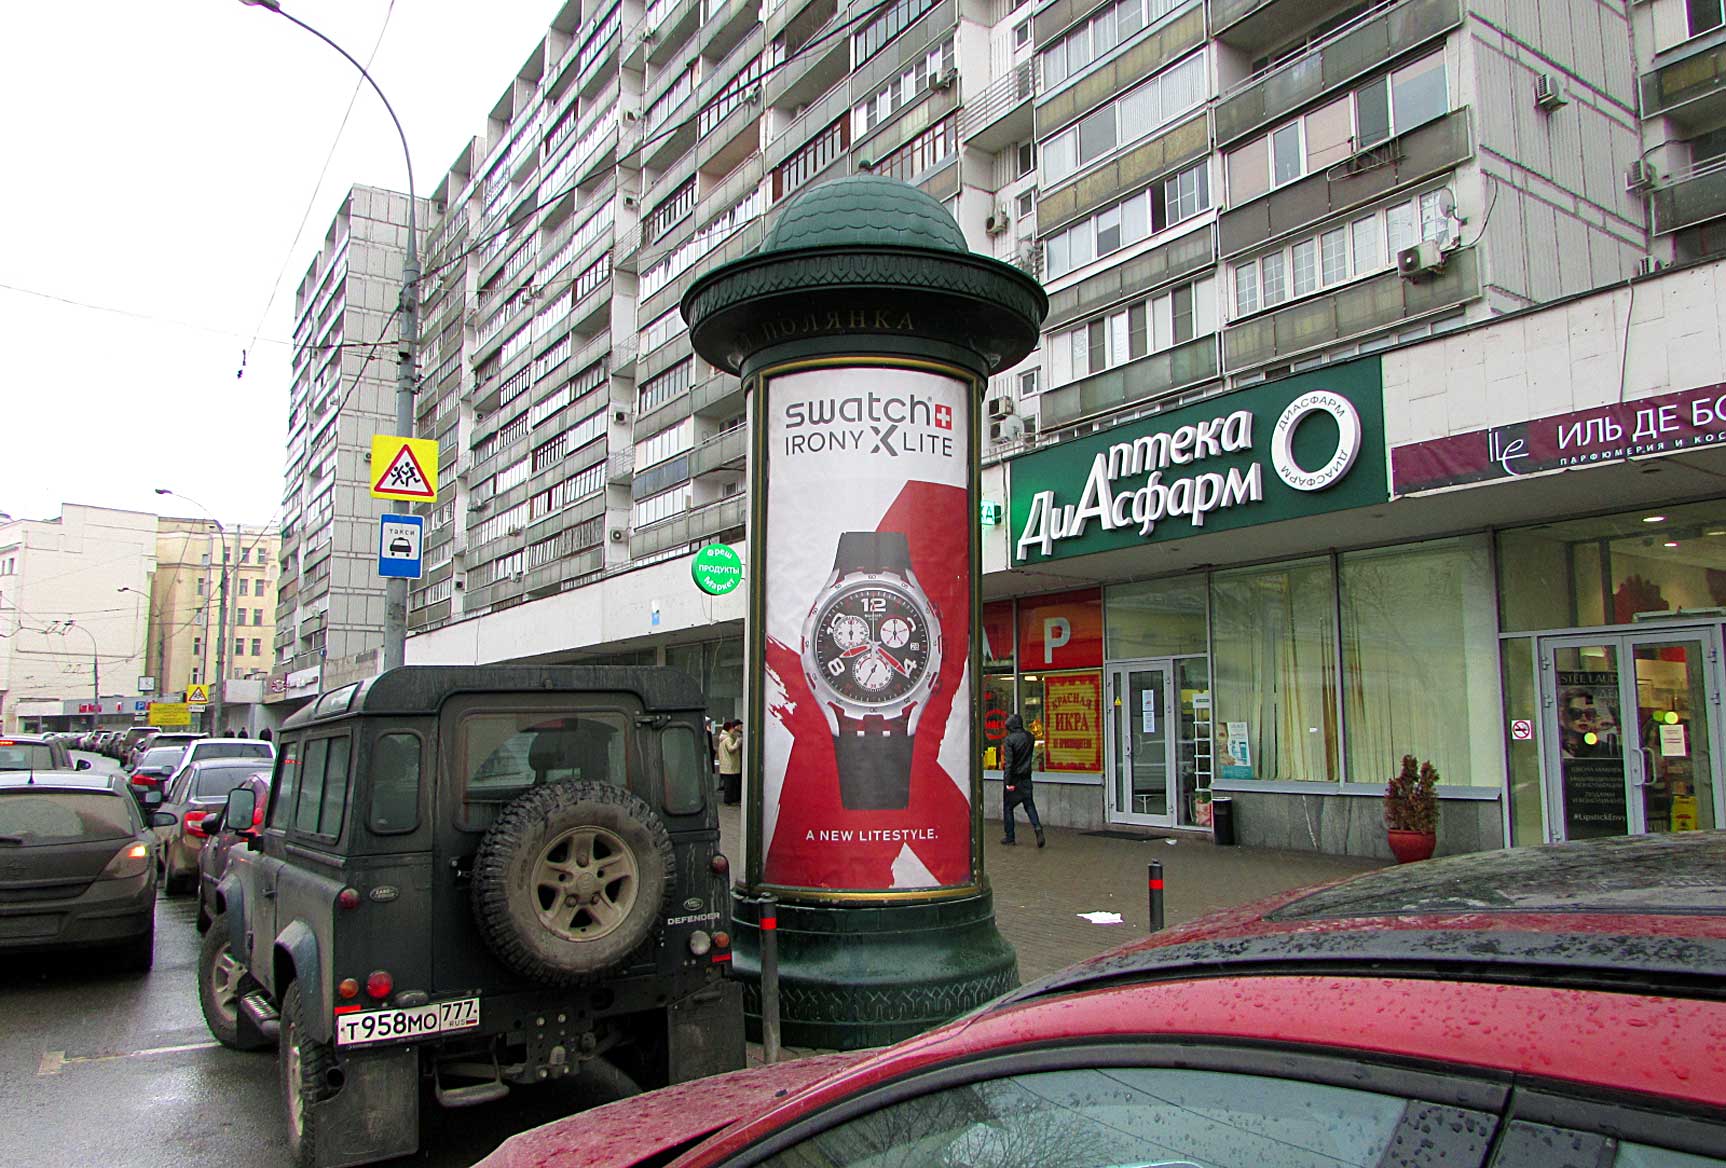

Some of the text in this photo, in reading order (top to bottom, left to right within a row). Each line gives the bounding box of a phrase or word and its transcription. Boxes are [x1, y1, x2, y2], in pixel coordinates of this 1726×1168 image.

[762, 310, 915, 340] ПОЛЯНКА
[1278, 396, 1345, 432] ДИАСФАРМ
[1557, 417, 1622, 450] ИЛЬ
[1632, 405, 1680, 442] ДЕ
[785, 430, 864, 456] IRONY
[904, 432, 953, 458] LITE
[1085, 410, 1253, 500] Аптека
[1559, 442, 1665, 466] ПАРФЮМЕРИЯ
[1675, 439, 1683, 448] И
[1281, 449, 1348, 486] ДИАСФАРМ
[1016, 453, 1262, 560] ДиАсфарм
[698, 564, 740, 575] ПРОДУКТЫ
[704, 576, 735, 592] Маркет
[861, 597, 887, 612] 12
[1055, 711, 1089, 731] ИКРА
[806, 828, 938, 842] A NEW LITESTYLE.
[667, 912, 720, 926] DEFENDER
[442, 1000, 474, 1021] 777
